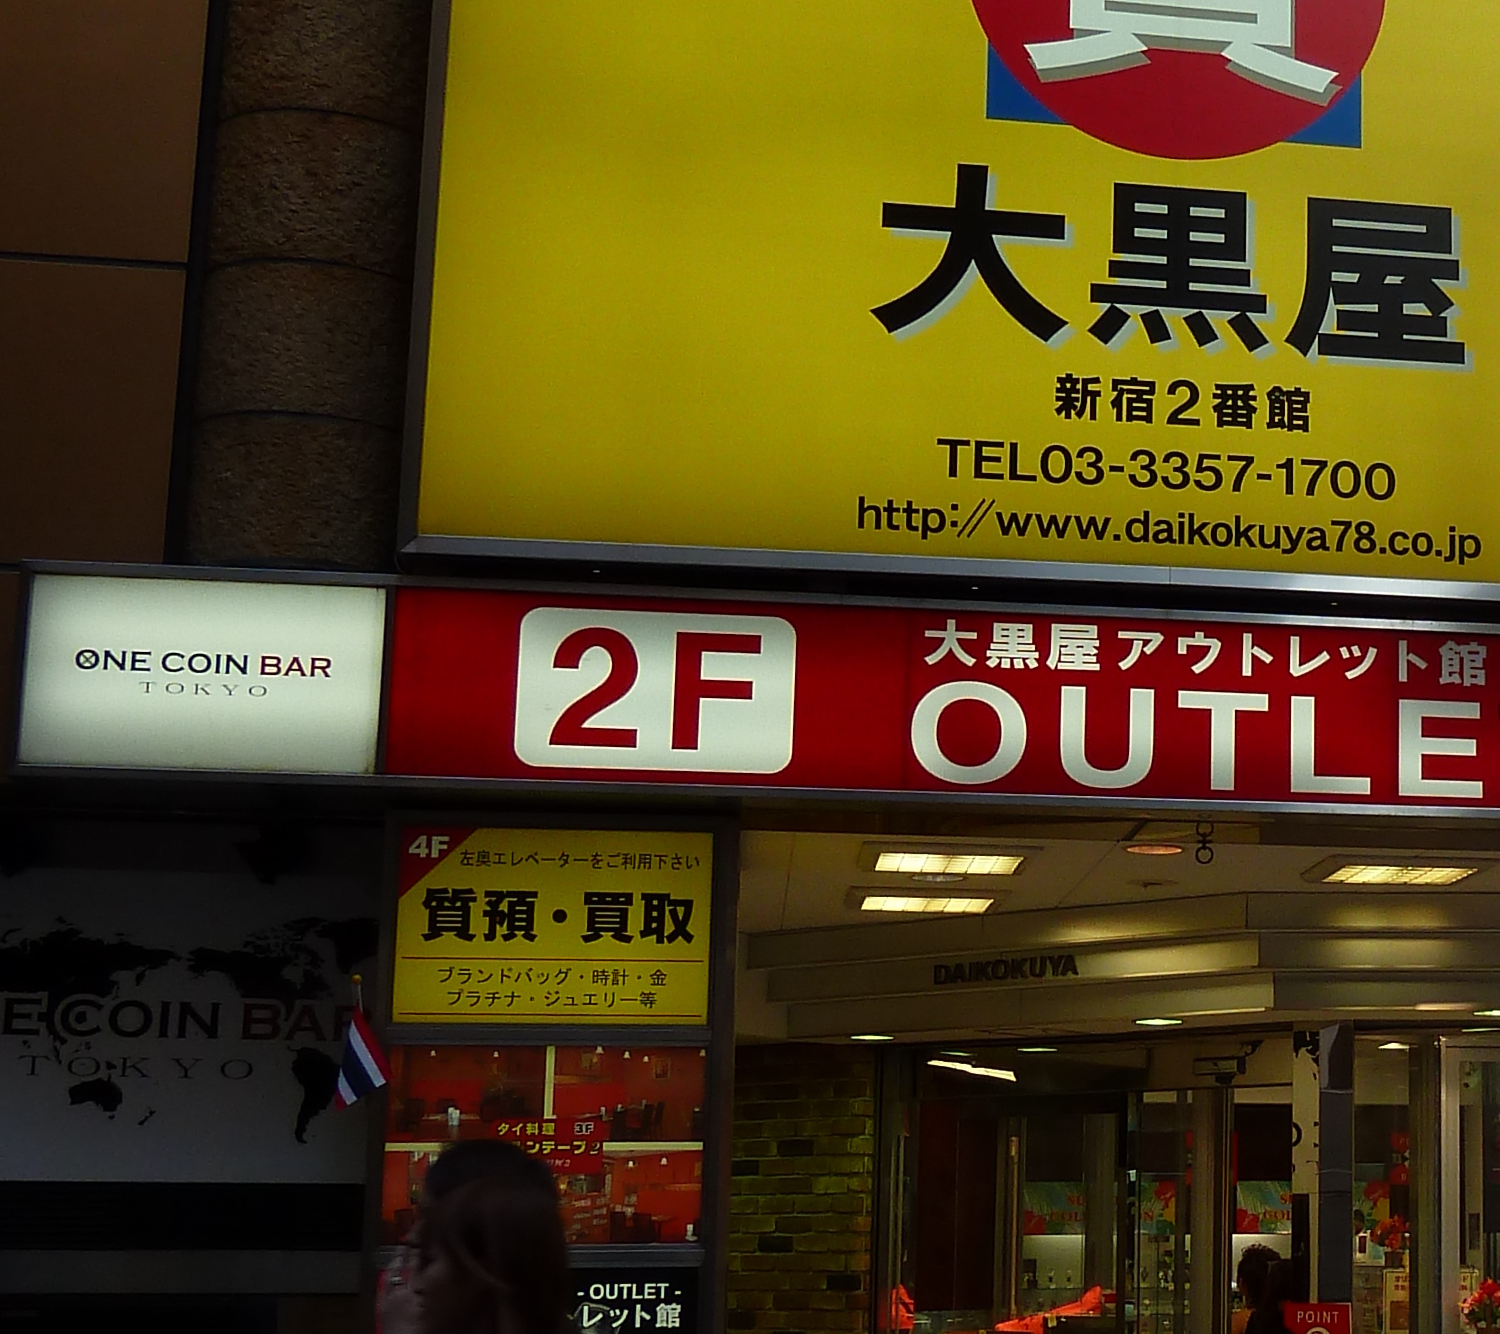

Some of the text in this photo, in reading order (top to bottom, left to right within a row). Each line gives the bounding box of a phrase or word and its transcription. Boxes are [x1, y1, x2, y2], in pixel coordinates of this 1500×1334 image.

[869, 162, 1473, 370] 大黒屋
[1054, 372, 1312, 433] 新宿2番館
[936, 437, 1397, 502] TEL03-3357-1700
[856, 495, 1484, 561] http://www.daikokuya78.co.jp
[75, 649, 332, 678] ONE COIN BAR
[923, 617, 1487, 686] 大黒屋アウトレット館
[139, 681, 268, 697] TOKYO
[547, 625, 763, 754] 2F
[408, 835, 450, 858] 4F
[460, 849, 700, 870] 左奥エレベーターをご利用下さい
[421, 887, 695, 945] 質預・買取
[934, 954, 1079, 985] DAIKOKUYA
[61, 1000, 222, 1039] COIN
[19, 1055, 253, 1079] TOKYO
[497, 1122, 595, 1136] タイ料理 3F
[589, 1283, 669, 1300] OUTLET
[1297, 1310, 1339, 1323] POINT
